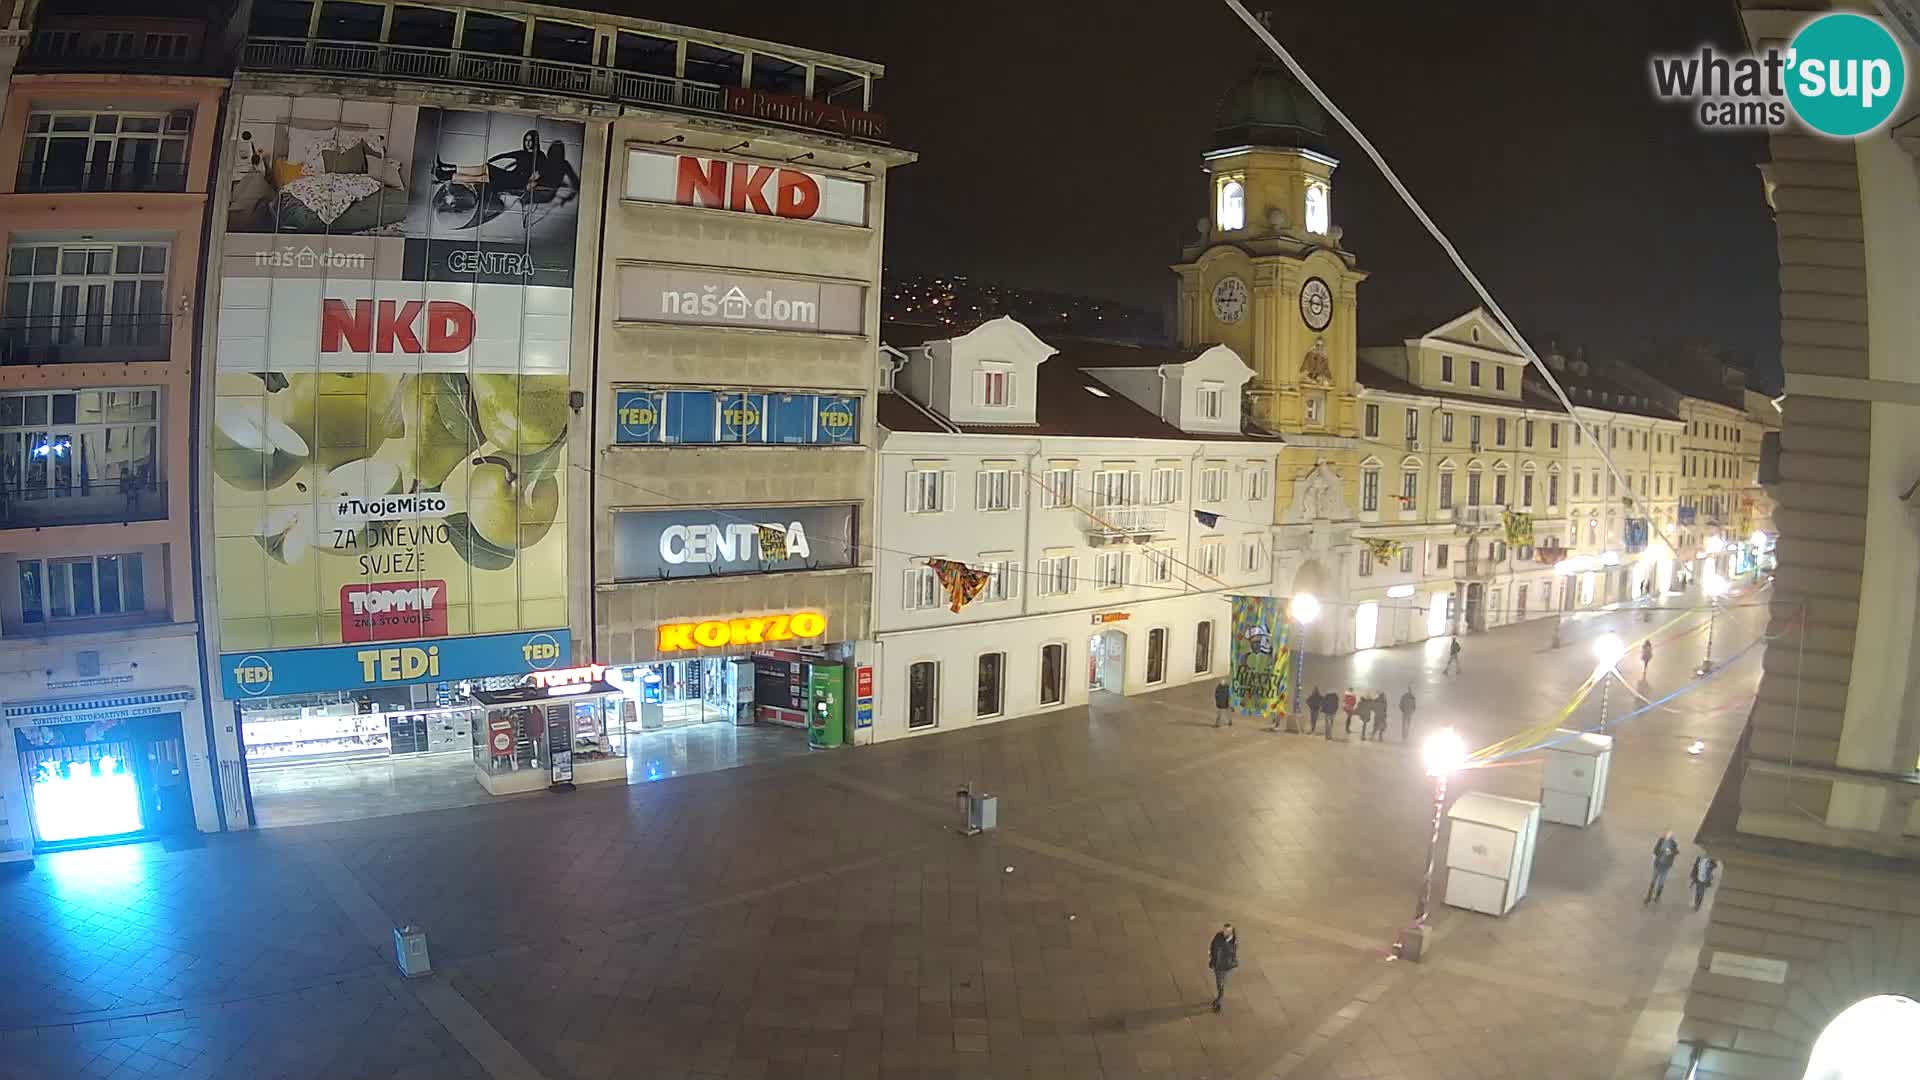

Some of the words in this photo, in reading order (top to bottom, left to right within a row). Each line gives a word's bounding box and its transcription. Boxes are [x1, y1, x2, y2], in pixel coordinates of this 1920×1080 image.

[676, 155, 820, 219] NKD
[319, 248, 365, 269] dom
[448, 250, 535, 275] CENTRA
[661, 285, 718, 316] naš
[754, 290, 816, 323] dom
[321, 298, 477, 353] NKD
[619, 408, 657, 425] TEDi
[723, 409, 760, 426] TEDi
[820, 411, 853, 427] TEDi
[338, 497, 446, 516] #TvojeMisto
[334, 529, 357, 548] ZA
[368, 525, 450, 548] DNEVNO
[360, 548, 426, 575] SVJEŽE
[349, 586, 439, 614] TOMMY
[657, 612, 825, 651] KORZO
[358, 646, 440, 683] TEDi
[522, 643, 560, 661] TEDi
[233, 666, 273, 683] TEDi
[533, 663, 608, 688] TOMMY
